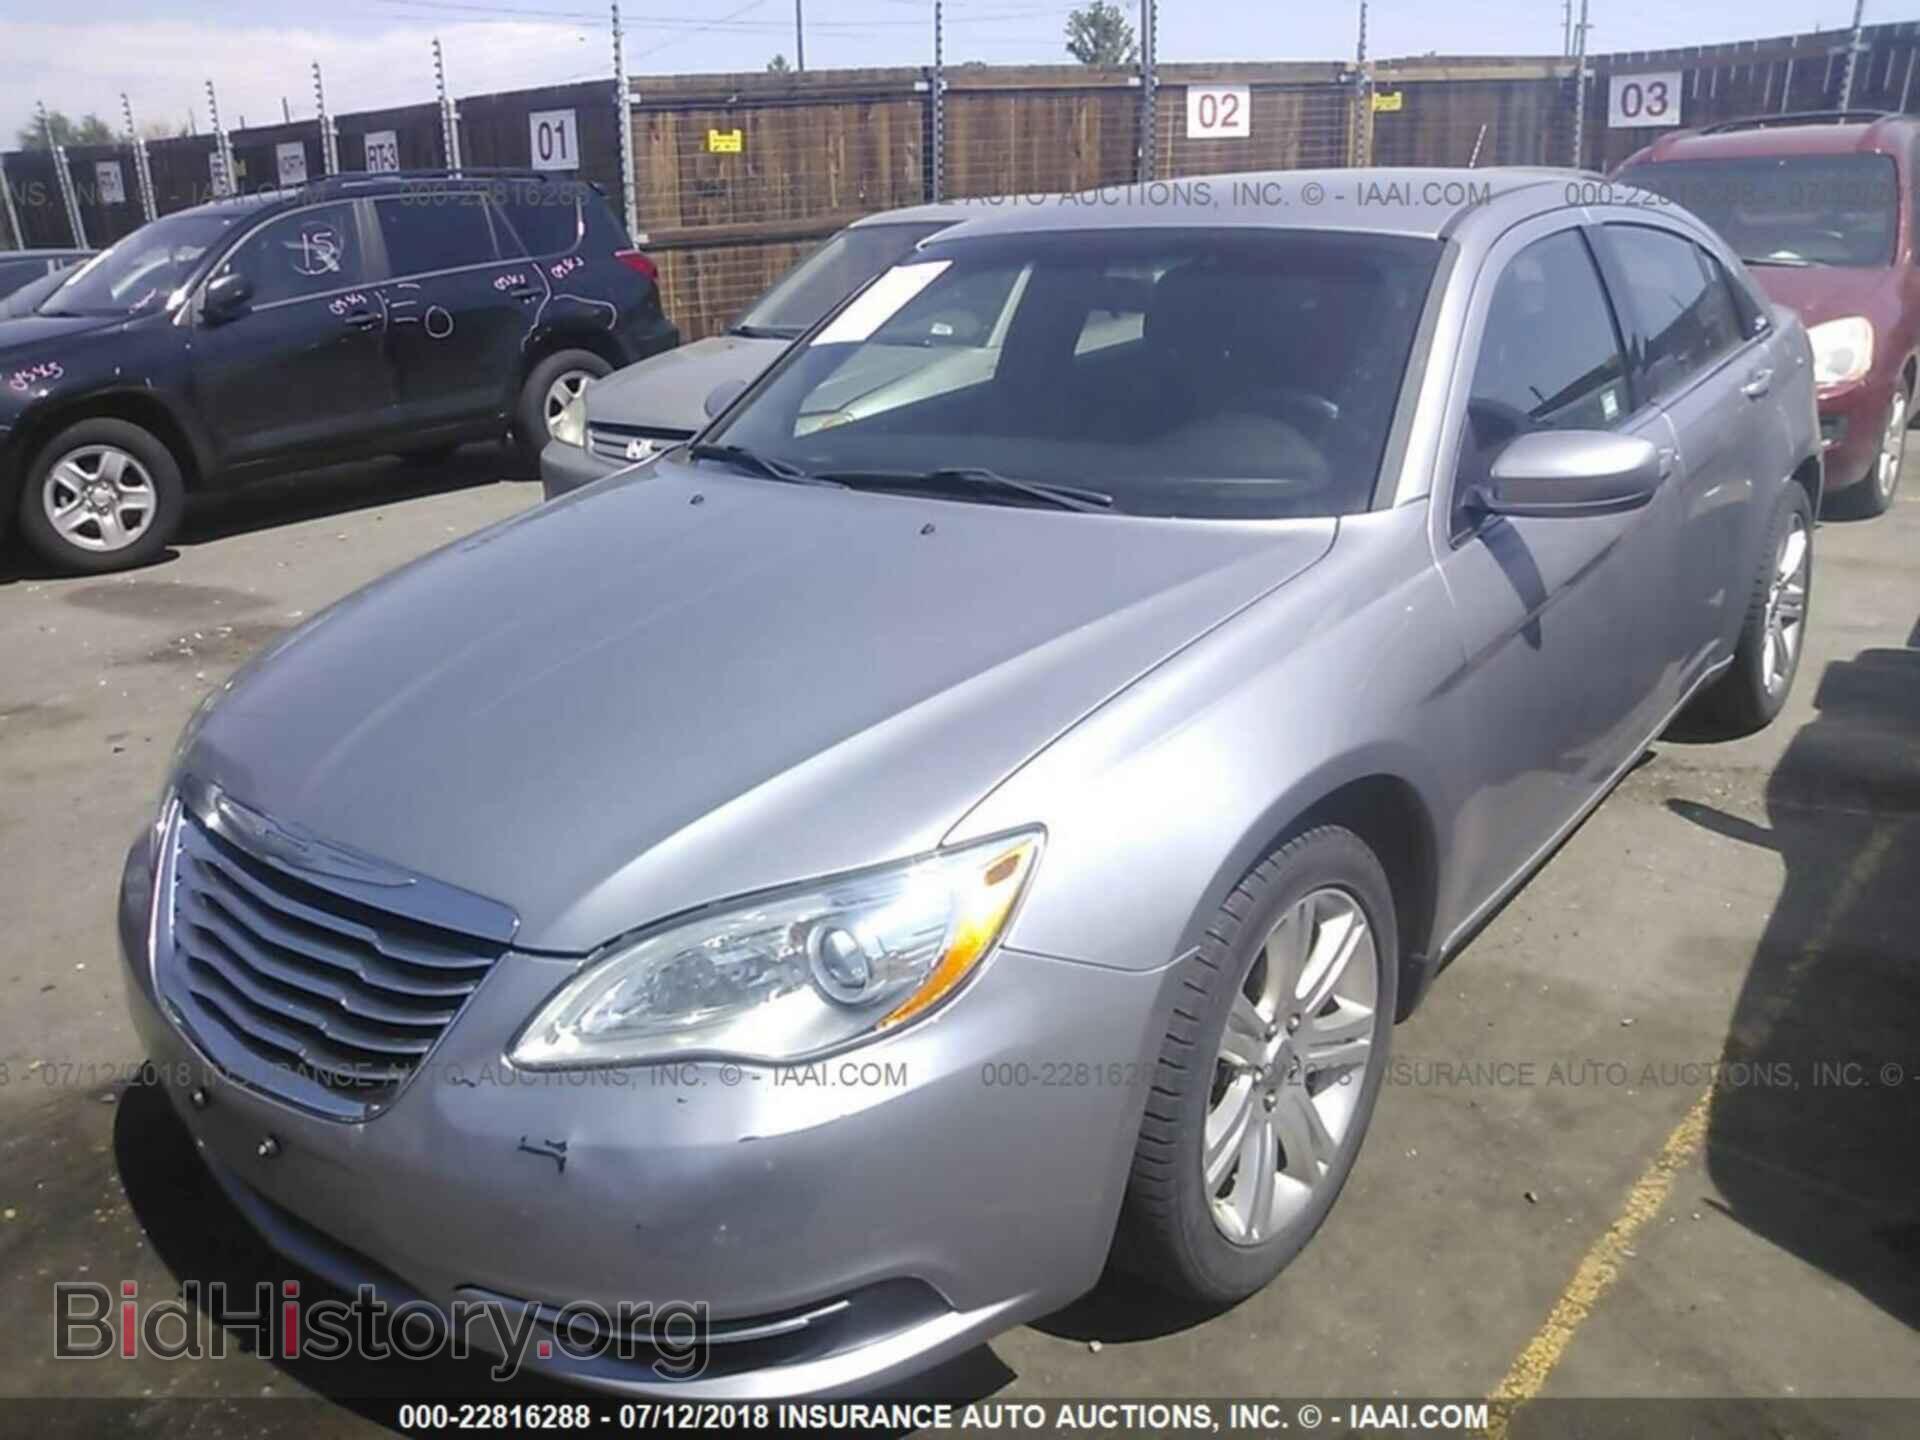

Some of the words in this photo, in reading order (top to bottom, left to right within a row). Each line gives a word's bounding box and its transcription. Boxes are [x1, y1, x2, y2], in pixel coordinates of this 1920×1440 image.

[1199, 94, 1240, 129] 02
[1621, 81, 1669, 118] 03
[538, 120, 567, 161] 01
